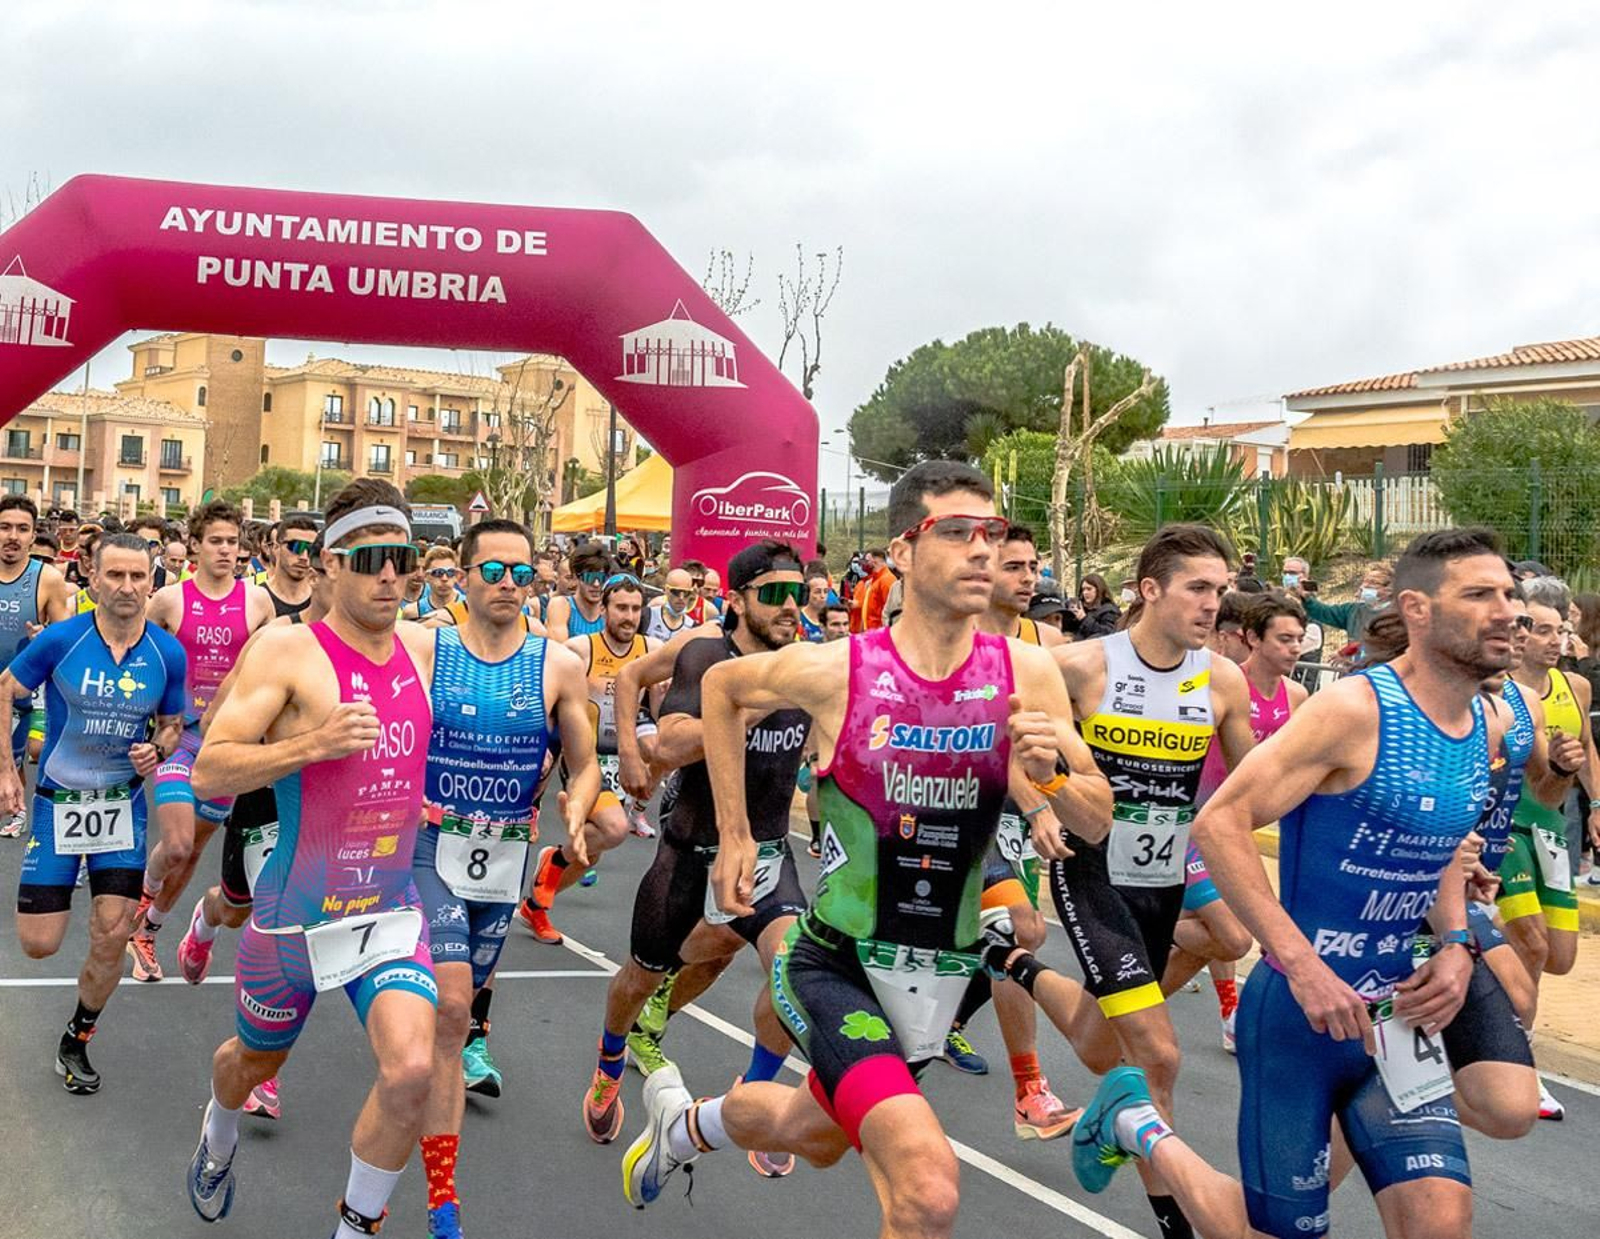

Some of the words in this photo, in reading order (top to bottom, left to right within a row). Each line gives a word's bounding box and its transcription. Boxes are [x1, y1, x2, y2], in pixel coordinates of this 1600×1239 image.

[159, 206, 483, 252] AYUNTAMIENTO
[496, 228, 548, 255] DE
[196, 255, 334, 293] PUNTA
[347, 266, 507, 304] UMBRIA
[718, 501, 790, 520] iberPark
[196, 626, 232, 645] RASO
[448, 730, 540, 744] MARPEDENTAL
[889, 722, 996, 753] SALTOKI
[439, 771, 521, 804] OROZCO
[883, 761, 979, 810] Valenzuela
[1110, 775, 1190, 801] Spiuk
[64, 808, 121, 838] 207
[337, 847, 370, 860] luces
[467, 848, 490, 881] 8
[1132, 833, 1175, 867] 34
[322, 895, 343, 913] No
[352, 921, 377, 955] 7
[1313, 928, 1369, 958] FAC
[1072, 925, 1104, 985] MÁLAGA
[244, 995, 293, 1019] LEOTRON
[773, 957, 807, 1034] SALTOKI
[1414, 1024, 1444, 1065] 4
[1406, 1153, 1445, 1172] ADS
